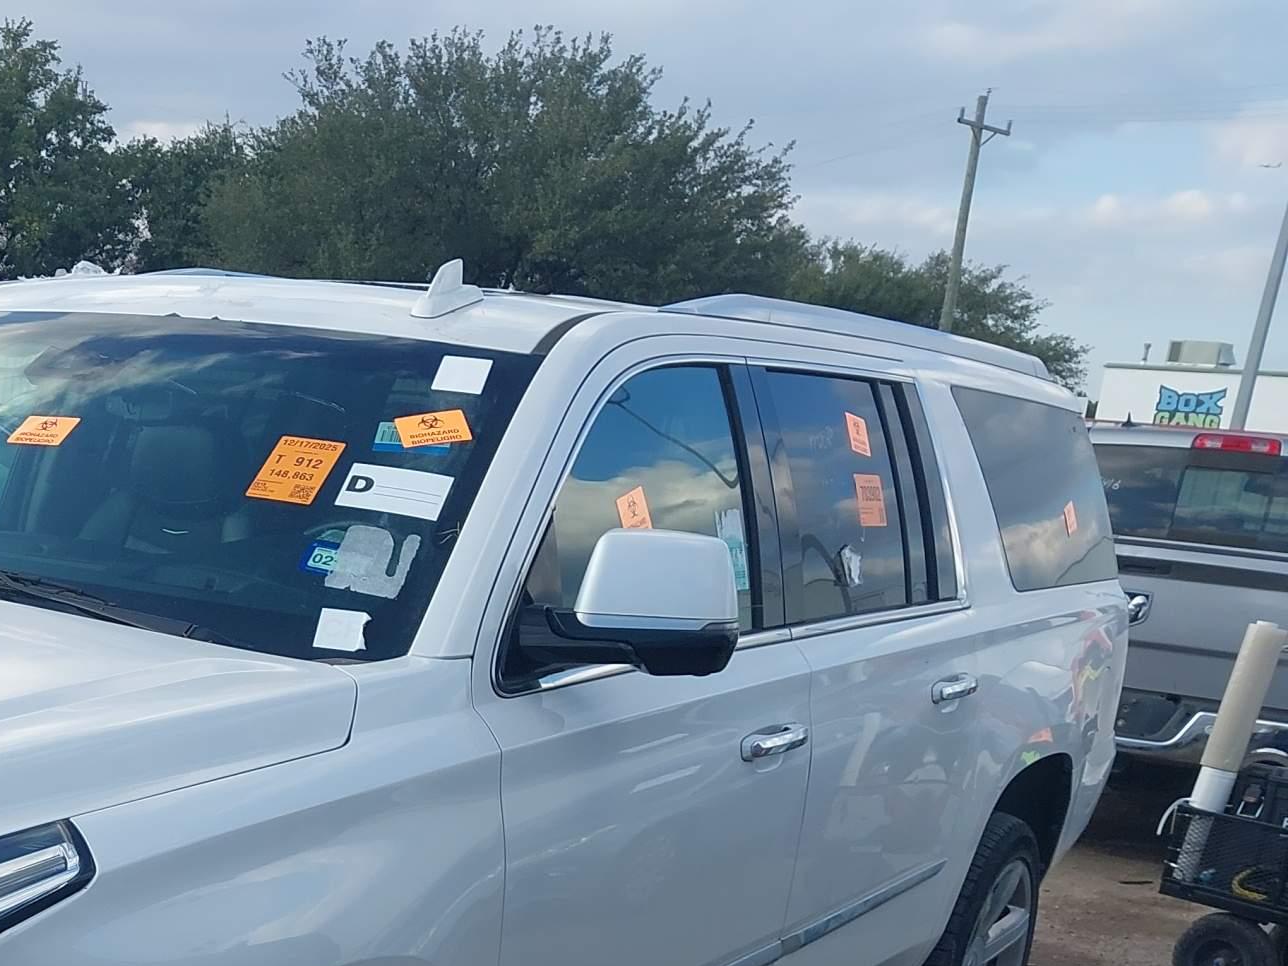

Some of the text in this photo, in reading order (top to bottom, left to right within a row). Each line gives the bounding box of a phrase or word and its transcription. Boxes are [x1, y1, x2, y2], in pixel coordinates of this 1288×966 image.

[1157, 385, 1229, 414] BOX
[1153, 410, 1221, 429] GANG
[409, 429, 460, 439] BIOHAZARD
[411, 434, 463, 445] BIOPELIGRO
[283, 438, 338, 452] 12/17/2025
[275, 454, 324, 469] T 912
[269, 468, 314, 481] 148,863
[345, 474, 375, 493] D
